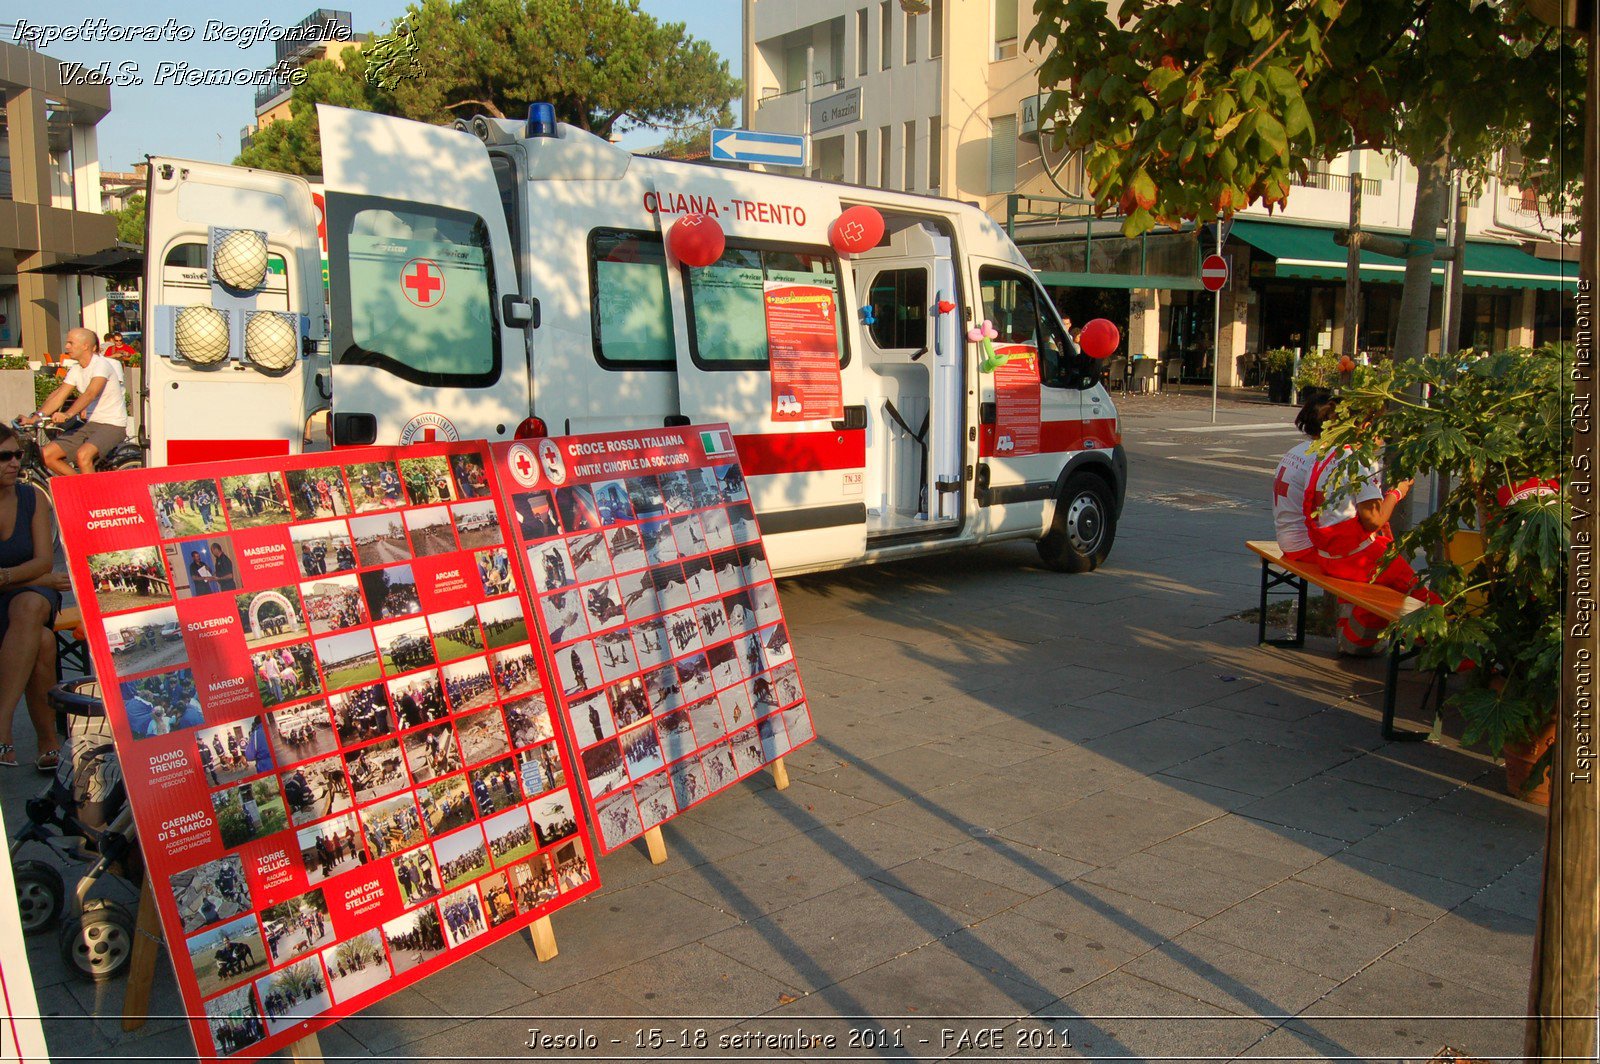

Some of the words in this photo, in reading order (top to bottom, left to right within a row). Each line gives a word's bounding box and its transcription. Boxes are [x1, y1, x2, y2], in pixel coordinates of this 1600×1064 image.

[832, 101, 857, 120] Mazzini
[731, 199, 806, 227] TRENTO
[568, 442, 606, 457] CROCE
[606, 438, 641, 453] ROSSA
[641, 434, 684, 449] ITALIANA
[602, 458, 640, 473] CINOFILE
[640, 456, 652, 469] DA
[651, 453, 689, 467] SOCCORSO
[845, 475, 853, 483] TN
[88, 505, 137, 519] VERIFICHE
[86, 513, 145, 530] OPERATIVITÀ
[243, 543, 287, 557] MASERADA
[435, 569, 460, 581] ARCADE
[187, 615, 235, 632] SOLFERINO
[208, 676, 245, 692] MARENO
[206, 700, 219, 709] CON
[218, 691, 255, 705] SCOLARESCHE
[208, 687, 250, 701] MANIFESTAZIONE
[149, 749, 184, 766] DUOMO
[149, 757, 189, 775] TREVISO
[148, 771, 184, 786] BENEDIZIONE
[161, 810, 205, 831] CAERANO
[157, 831, 169, 842] DI
[169, 829, 179, 839] S.
[179, 817, 213, 836] MARCO
[168, 844, 189, 857] CAMPO
[257, 849, 286, 866] TORRE
[257, 857, 291, 877] PELLICE
[344, 886, 364, 901] CANI
[362, 879, 380, 893] CON
[344, 887, 385, 912] STELLETTE
